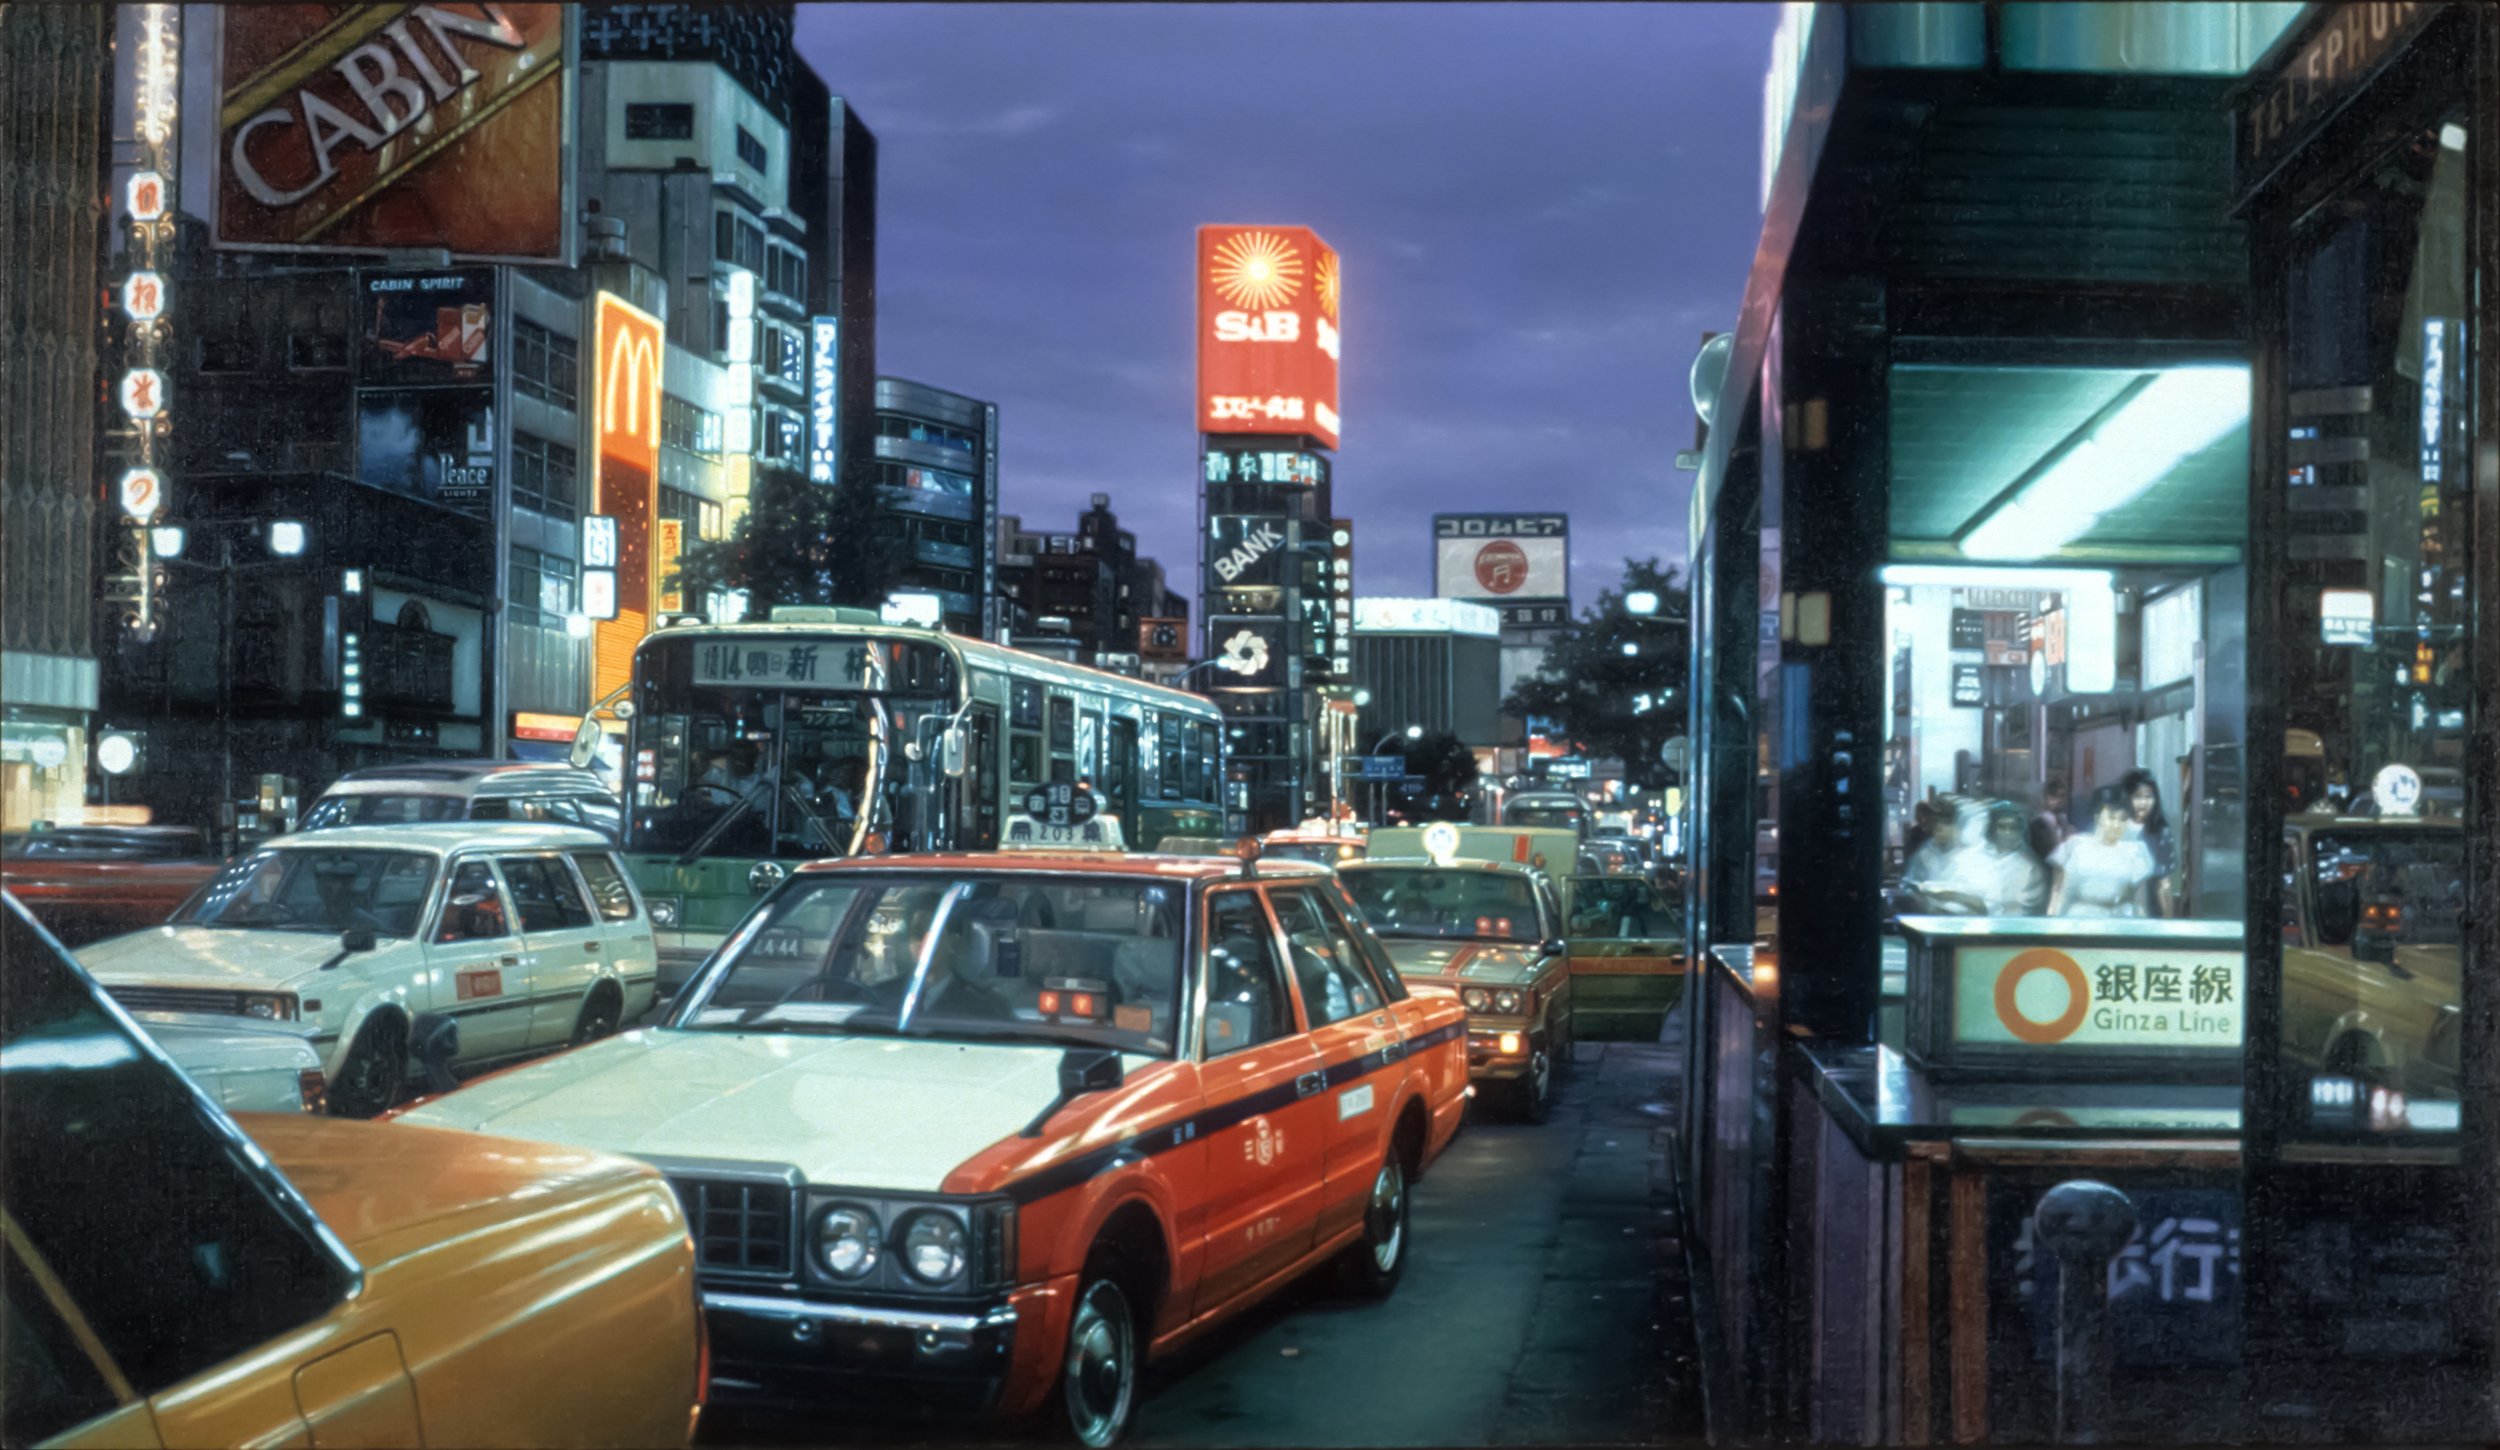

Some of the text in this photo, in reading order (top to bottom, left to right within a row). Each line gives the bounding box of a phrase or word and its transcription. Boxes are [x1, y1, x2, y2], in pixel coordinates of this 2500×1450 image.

[232, 3, 526, 207] CABIN
[370, 276, 464, 292] CABIN SPIRIT
[439, 452, 487, 485] Peace
[1213, 522, 1285, 583] BANK
[1040, 826, 1073, 842] 203
[2094, 963, 2234, 1005] 銀座線
[2093, 1007, 2231, 1034] Ginza Line
